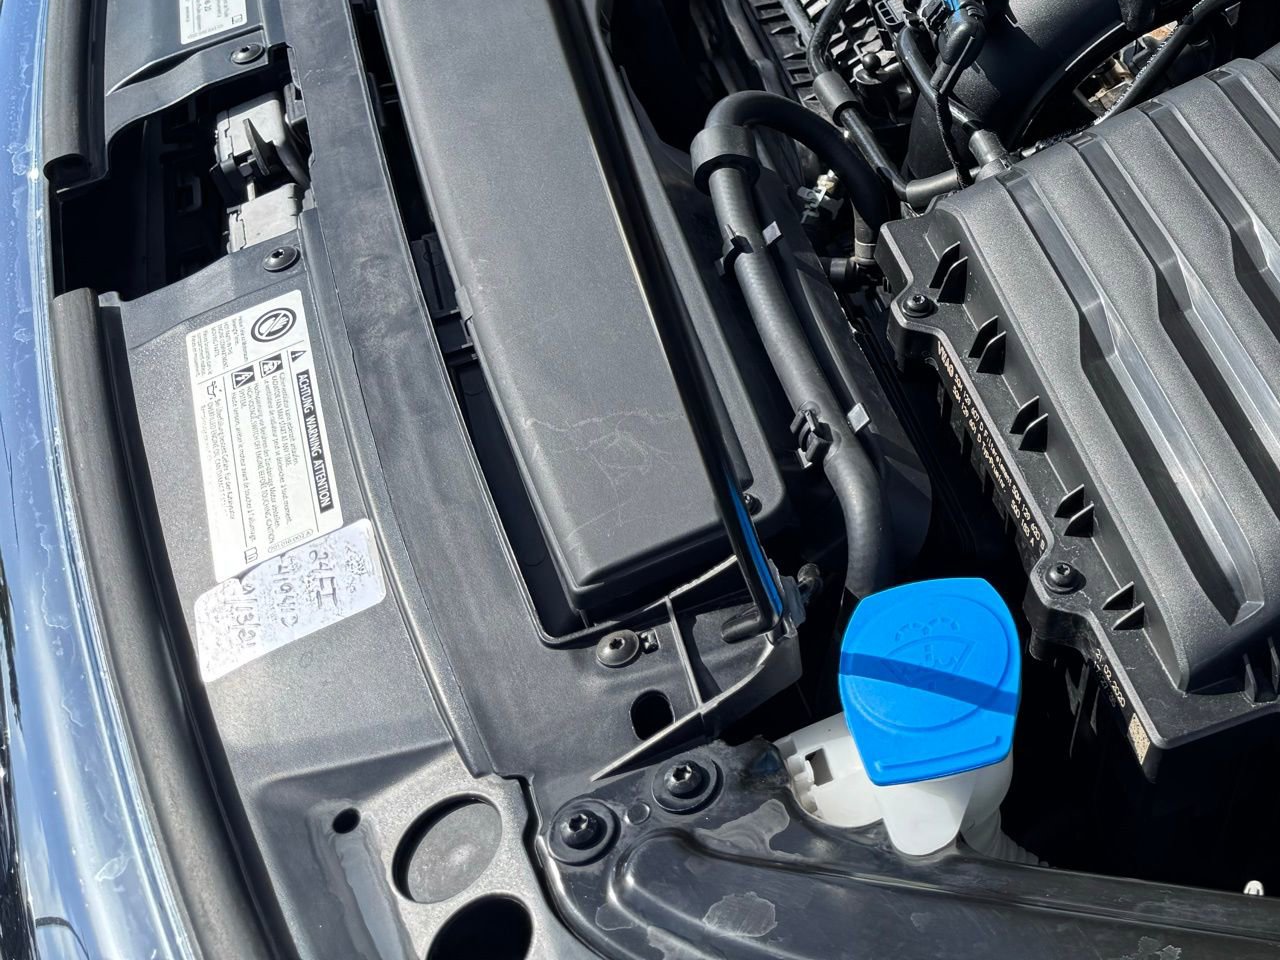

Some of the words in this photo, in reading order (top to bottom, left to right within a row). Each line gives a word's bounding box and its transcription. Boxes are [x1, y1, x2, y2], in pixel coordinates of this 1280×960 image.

[297, 373, 314, 413] ACHTUNG
[960, 401, 969, 417] 129
[305, 414, 322, 457] WARNING
[962, 390, 971, 406] 129
[983, 429, 1012, 486] Filterelement
[1021, 503, 1031, 520] 129
[312, 459, 330, 507] ATTENTION
